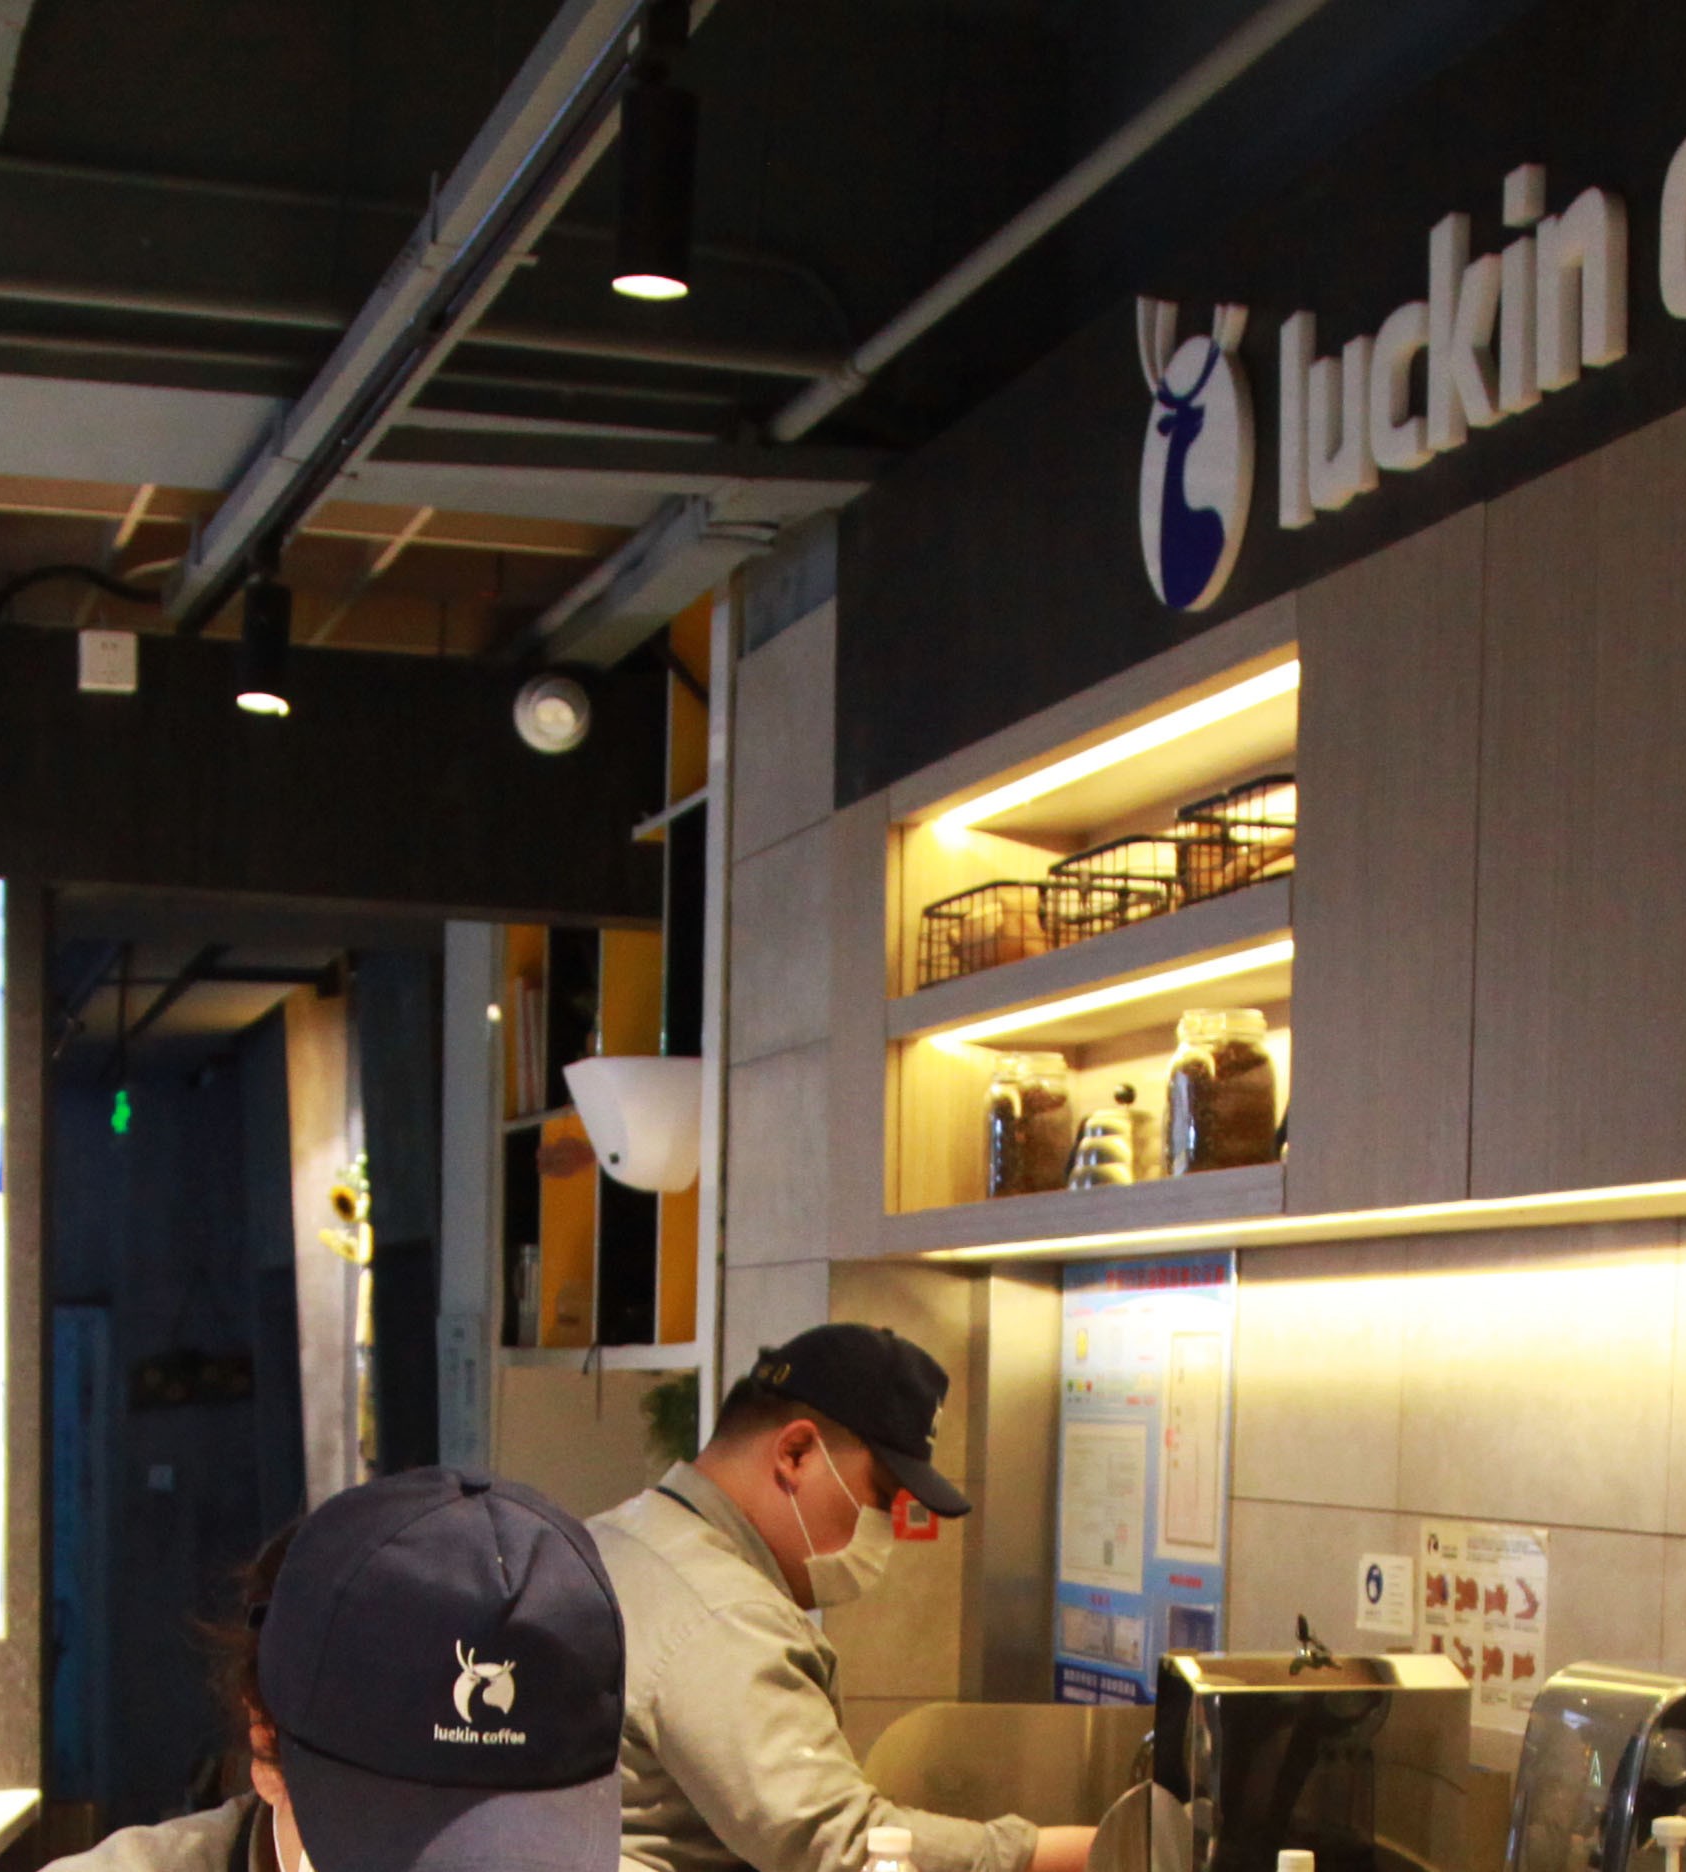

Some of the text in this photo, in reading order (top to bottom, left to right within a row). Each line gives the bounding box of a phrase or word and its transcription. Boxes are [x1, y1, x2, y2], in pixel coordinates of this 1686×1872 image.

[1280, 163, 1627, 530] luckin
[434, 1723, 526, 1745] luckin coffee
